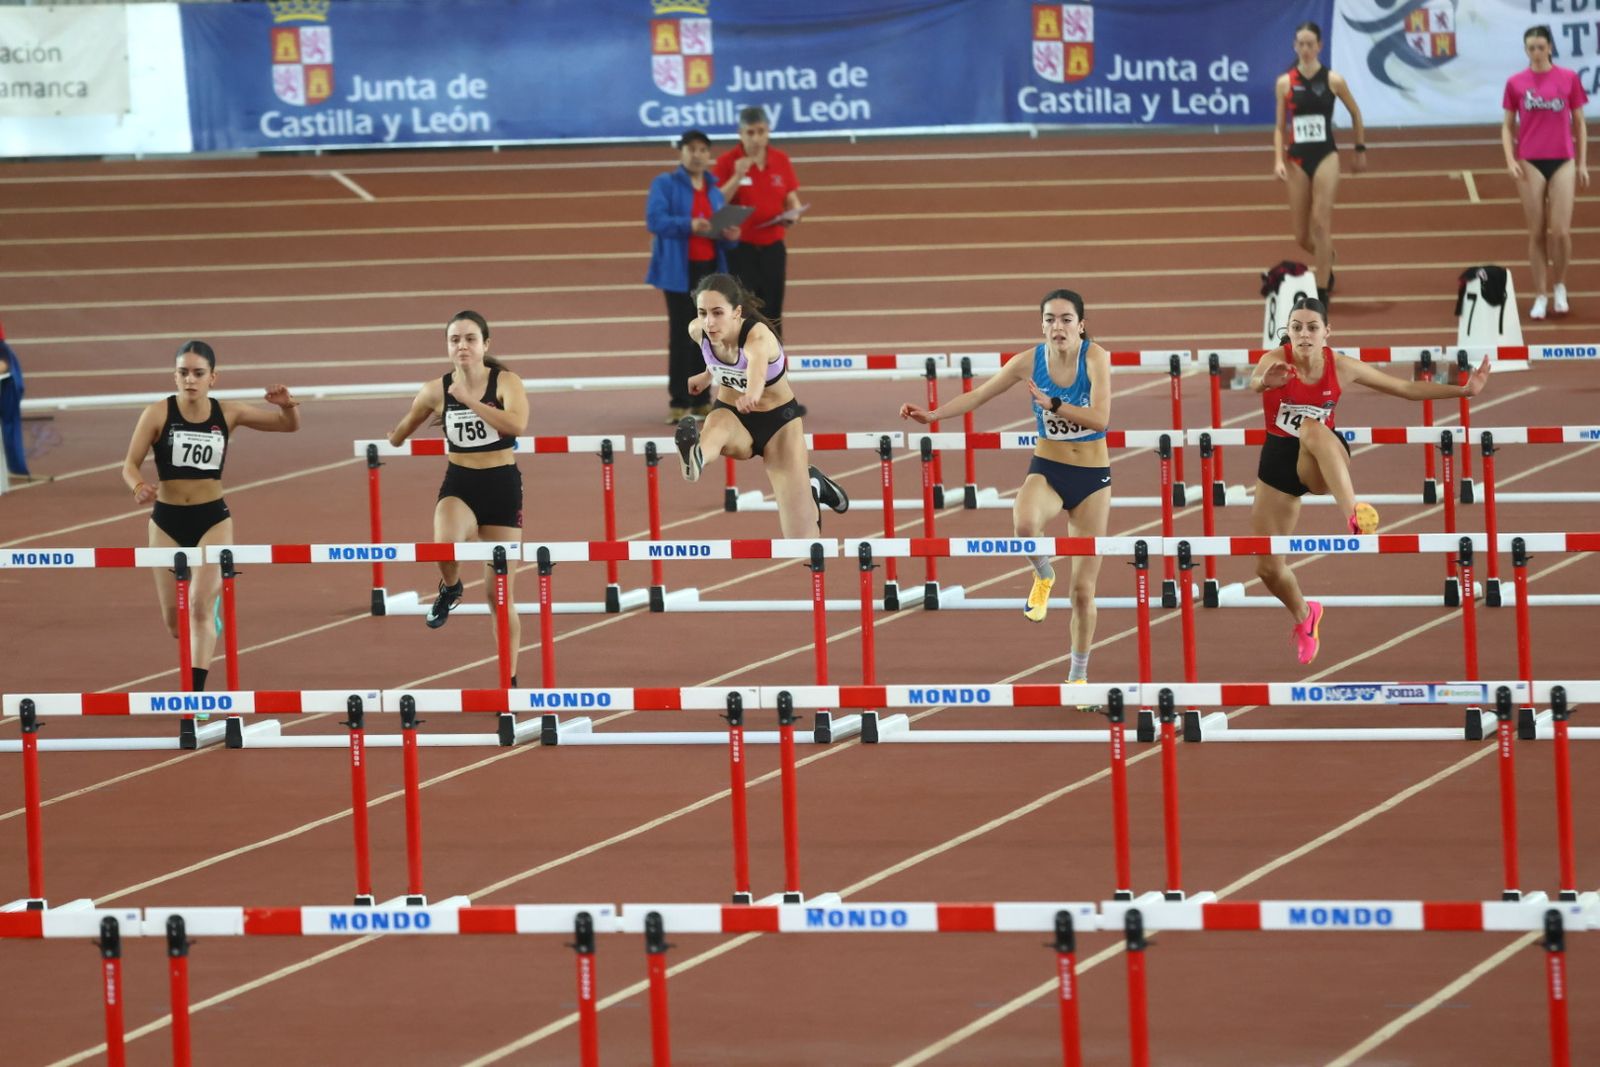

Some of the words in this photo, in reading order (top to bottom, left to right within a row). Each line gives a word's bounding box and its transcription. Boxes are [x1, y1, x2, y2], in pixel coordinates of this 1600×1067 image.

[727, 65, 818, 93] Junta
[827, 61, 869, 89] de
[1106, 54, 1198, 82] Junta
[1208, 55, 1250, 82] de
[346, 74, 438, 103] Junta
[447, 72, 488, 100] de
[762, 102, 782, 132] y
[792, 93, 871, 123] León
[1017, 86, 1131, 114] Castilla
[1140, 93, 1161, 122] y
[1171, 83, 1250, 113] León
[259, 108, 374, 139] Castilla
[382, 112, 402, 142] y
[411, 105, 491, 134] León
[1296, 122, 1323, 138] 1123
[1268, 296, 1277, 341] 8
[1466, 293, 1478, 337] 7
[800, 357, 854, 369] MONDO
[1541, 346, 1598, 359] MONDO
[454, 421, 485, 442] 758
[1046, 419, 1088, 435] 333
[181, 443, 213, 464] 760
[327, 545, 398, 561] MONDO
[648, 544, 712, 558] MONDO
[965, 539, 1038, 555] MONDO
[1287, 536, 1361, 553] MONDO
[11, 552, 75, 566] MONDO
[150, 695, 233, 712] MONDO
[529, 690, 613, 709] MONDO
[908, 687, 992, 705] MONDO
[328, 911, 433, 932] MONDO
[805, 907, 909, 929] MONDO
[1287, 906, 1394, 928] MONDO
